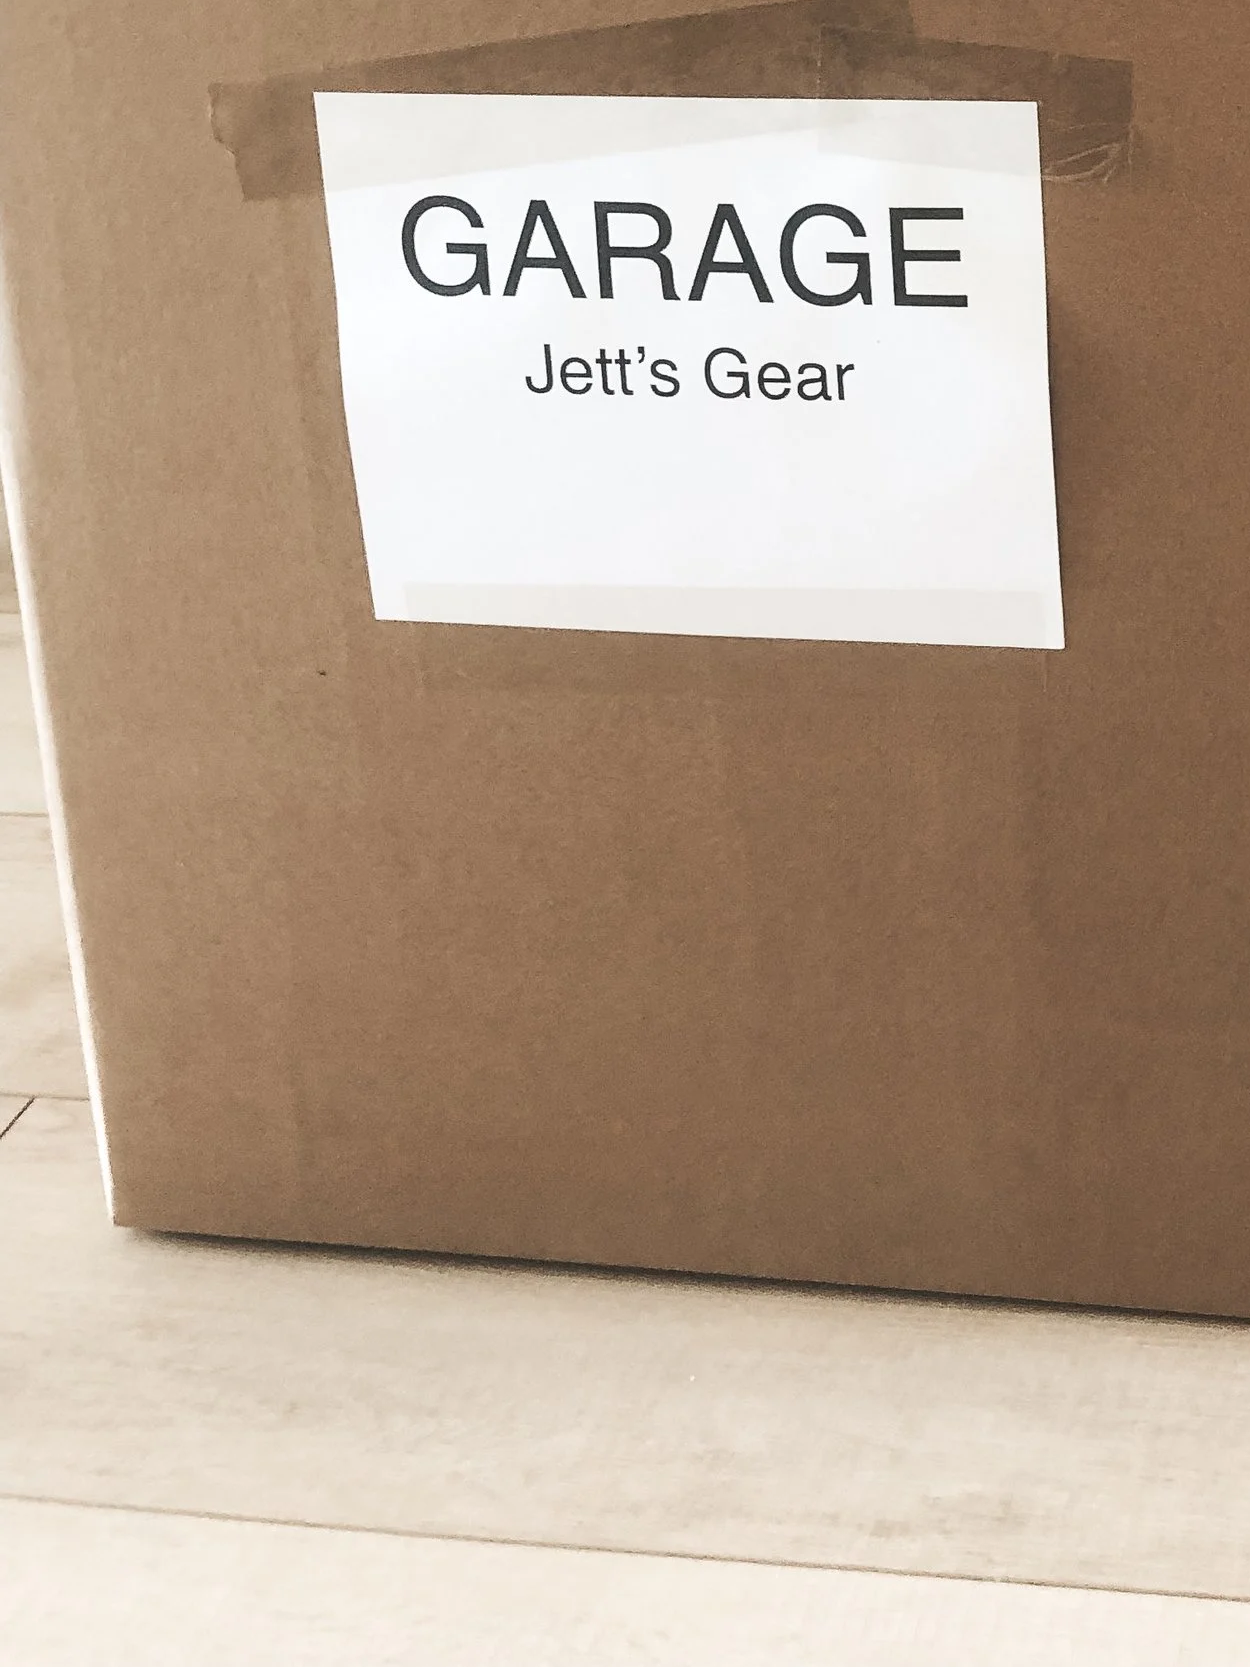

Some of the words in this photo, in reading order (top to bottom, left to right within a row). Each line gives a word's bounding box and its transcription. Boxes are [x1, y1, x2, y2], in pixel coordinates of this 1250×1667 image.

[402, 195, 969, 308] GARAGE
[525, 343, 680, 397] Jett's
[704, 347, 855, 401] Gear
